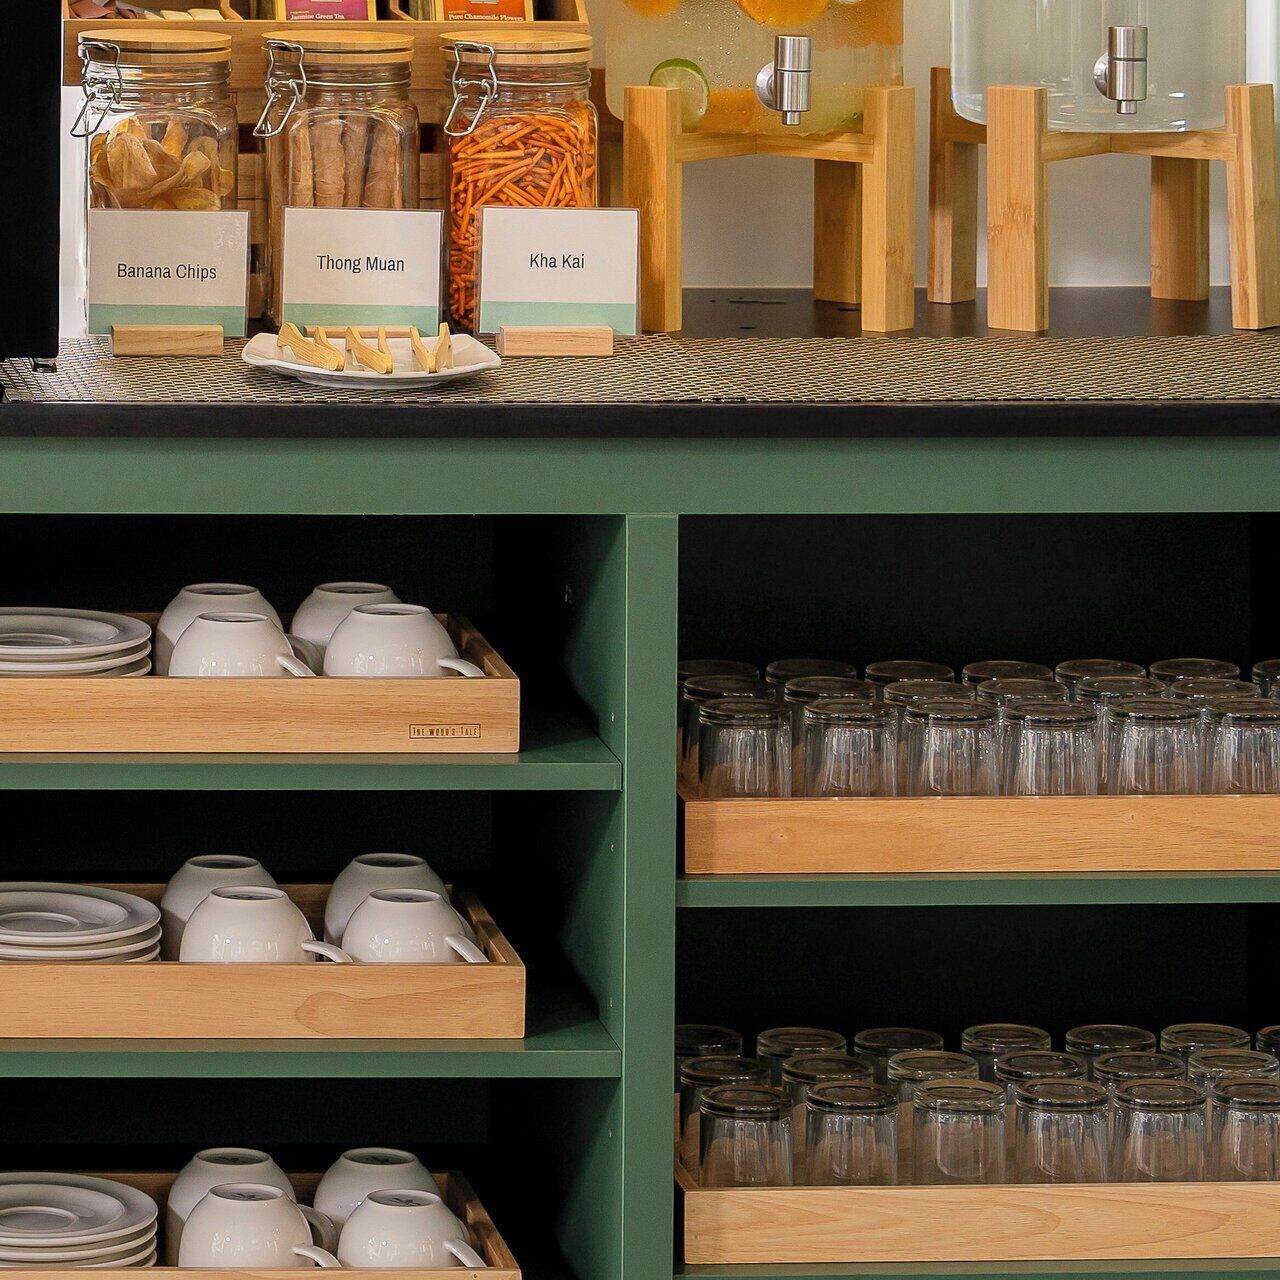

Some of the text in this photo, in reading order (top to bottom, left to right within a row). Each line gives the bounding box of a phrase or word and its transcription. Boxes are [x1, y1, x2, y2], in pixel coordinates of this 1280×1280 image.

[316, 255, 405, 273] Thong Muan
[529, 253, 585, 269] Kha Kai
[117, 263, 217, 281] Banana Chips
[413, 727, 425, 736] THE
[461, 727, 477, 736] TALE
